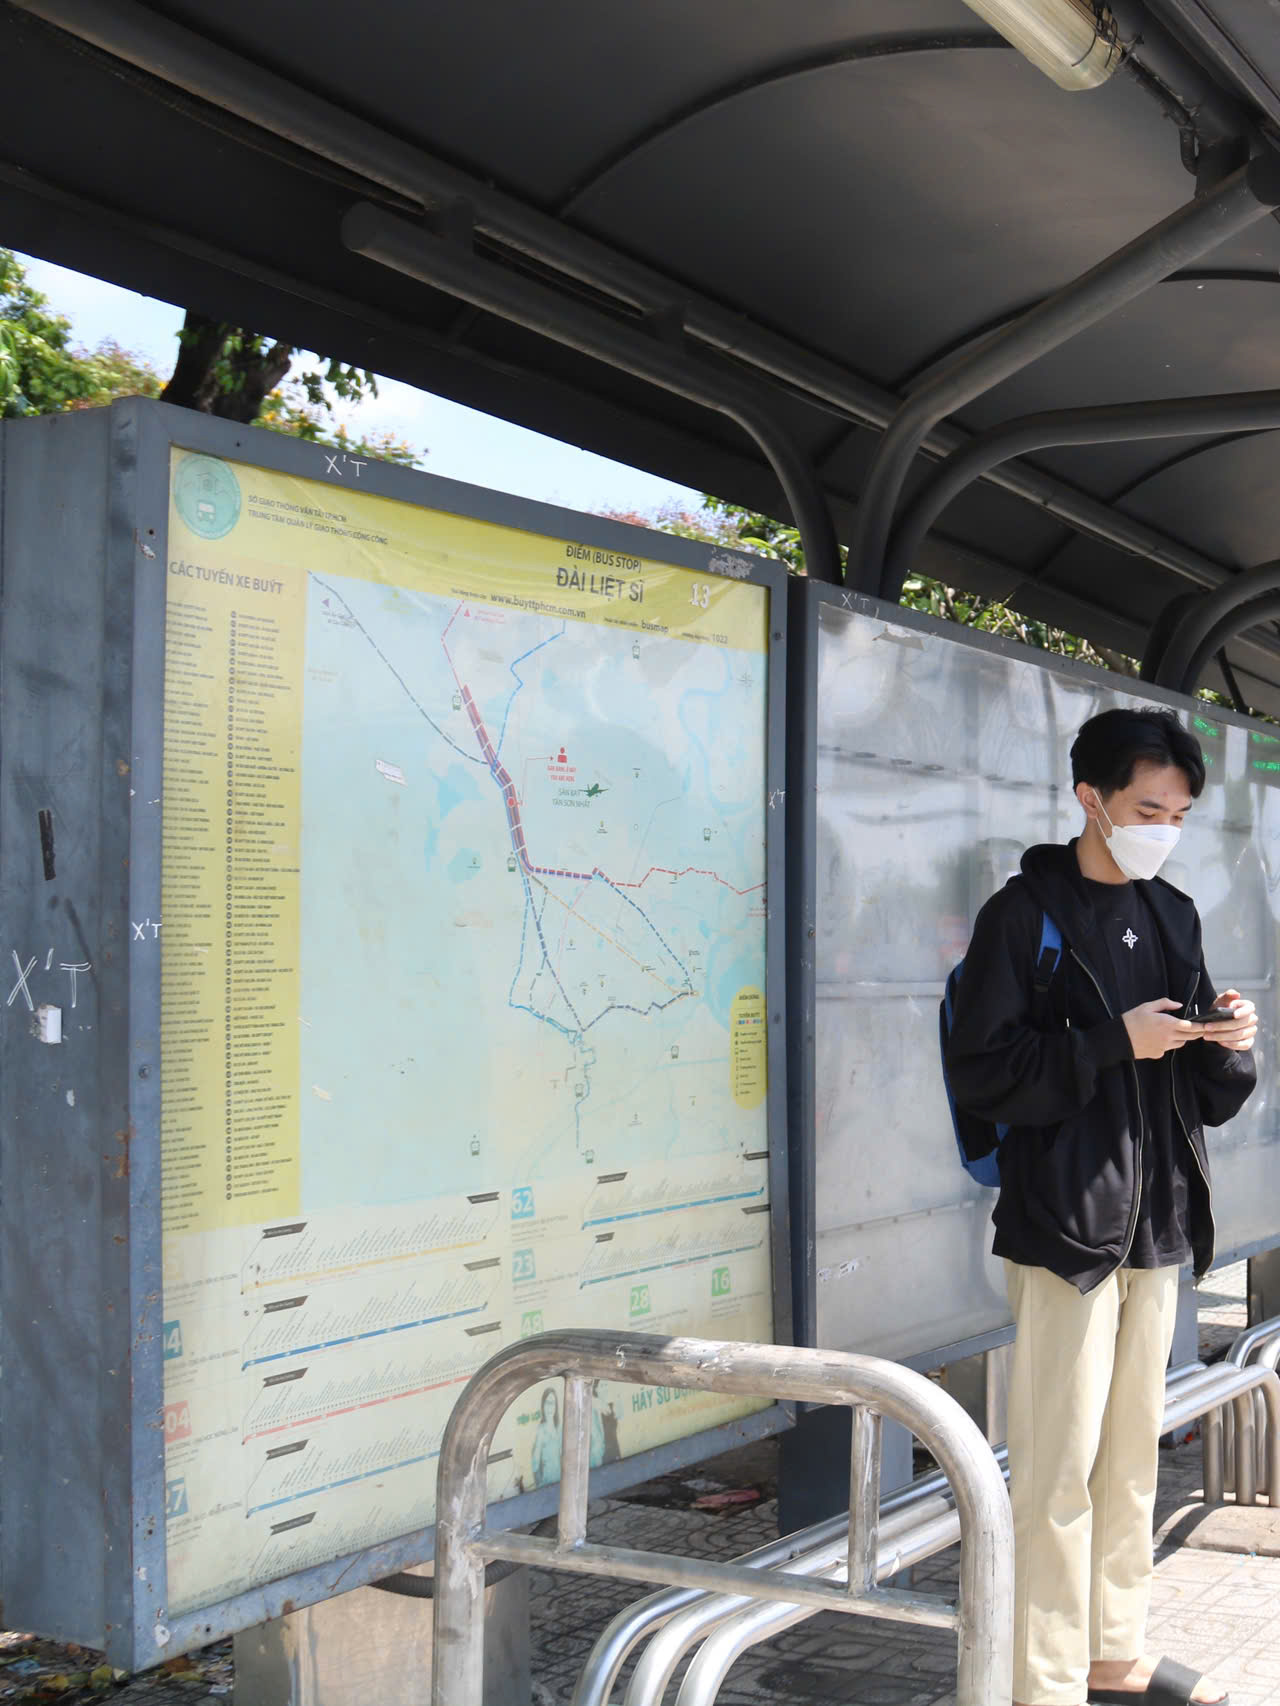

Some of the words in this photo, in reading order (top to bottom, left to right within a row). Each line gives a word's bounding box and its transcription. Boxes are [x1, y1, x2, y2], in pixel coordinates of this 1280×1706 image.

[592, 551, 614, 566] (BUS
[615, 556, 642, 573] STOP)
[169, 560, 193, 578] CÁC
[195, 566, 234, 586] TUYẾN
[236, 574, 251, 589] XE
[252, 578, 285, 594] BUÝT
[556, 564, 586, 592] ĐÀI
[590, 574, 625, 601] LIỆT
[490, 594, 586, 618] www.buyttphcm.com.vn
[690, 583, 711, 608] 13
[641, 620, 669, 634] busmap
[512, 1190, 534, 1214] 62
[512, 1254, 535, 1277] 23
[713, 1270, 730, 1293] 16
[631, 1287, 649, 1311] 28
[163, 1328, 182, 1354] 4
